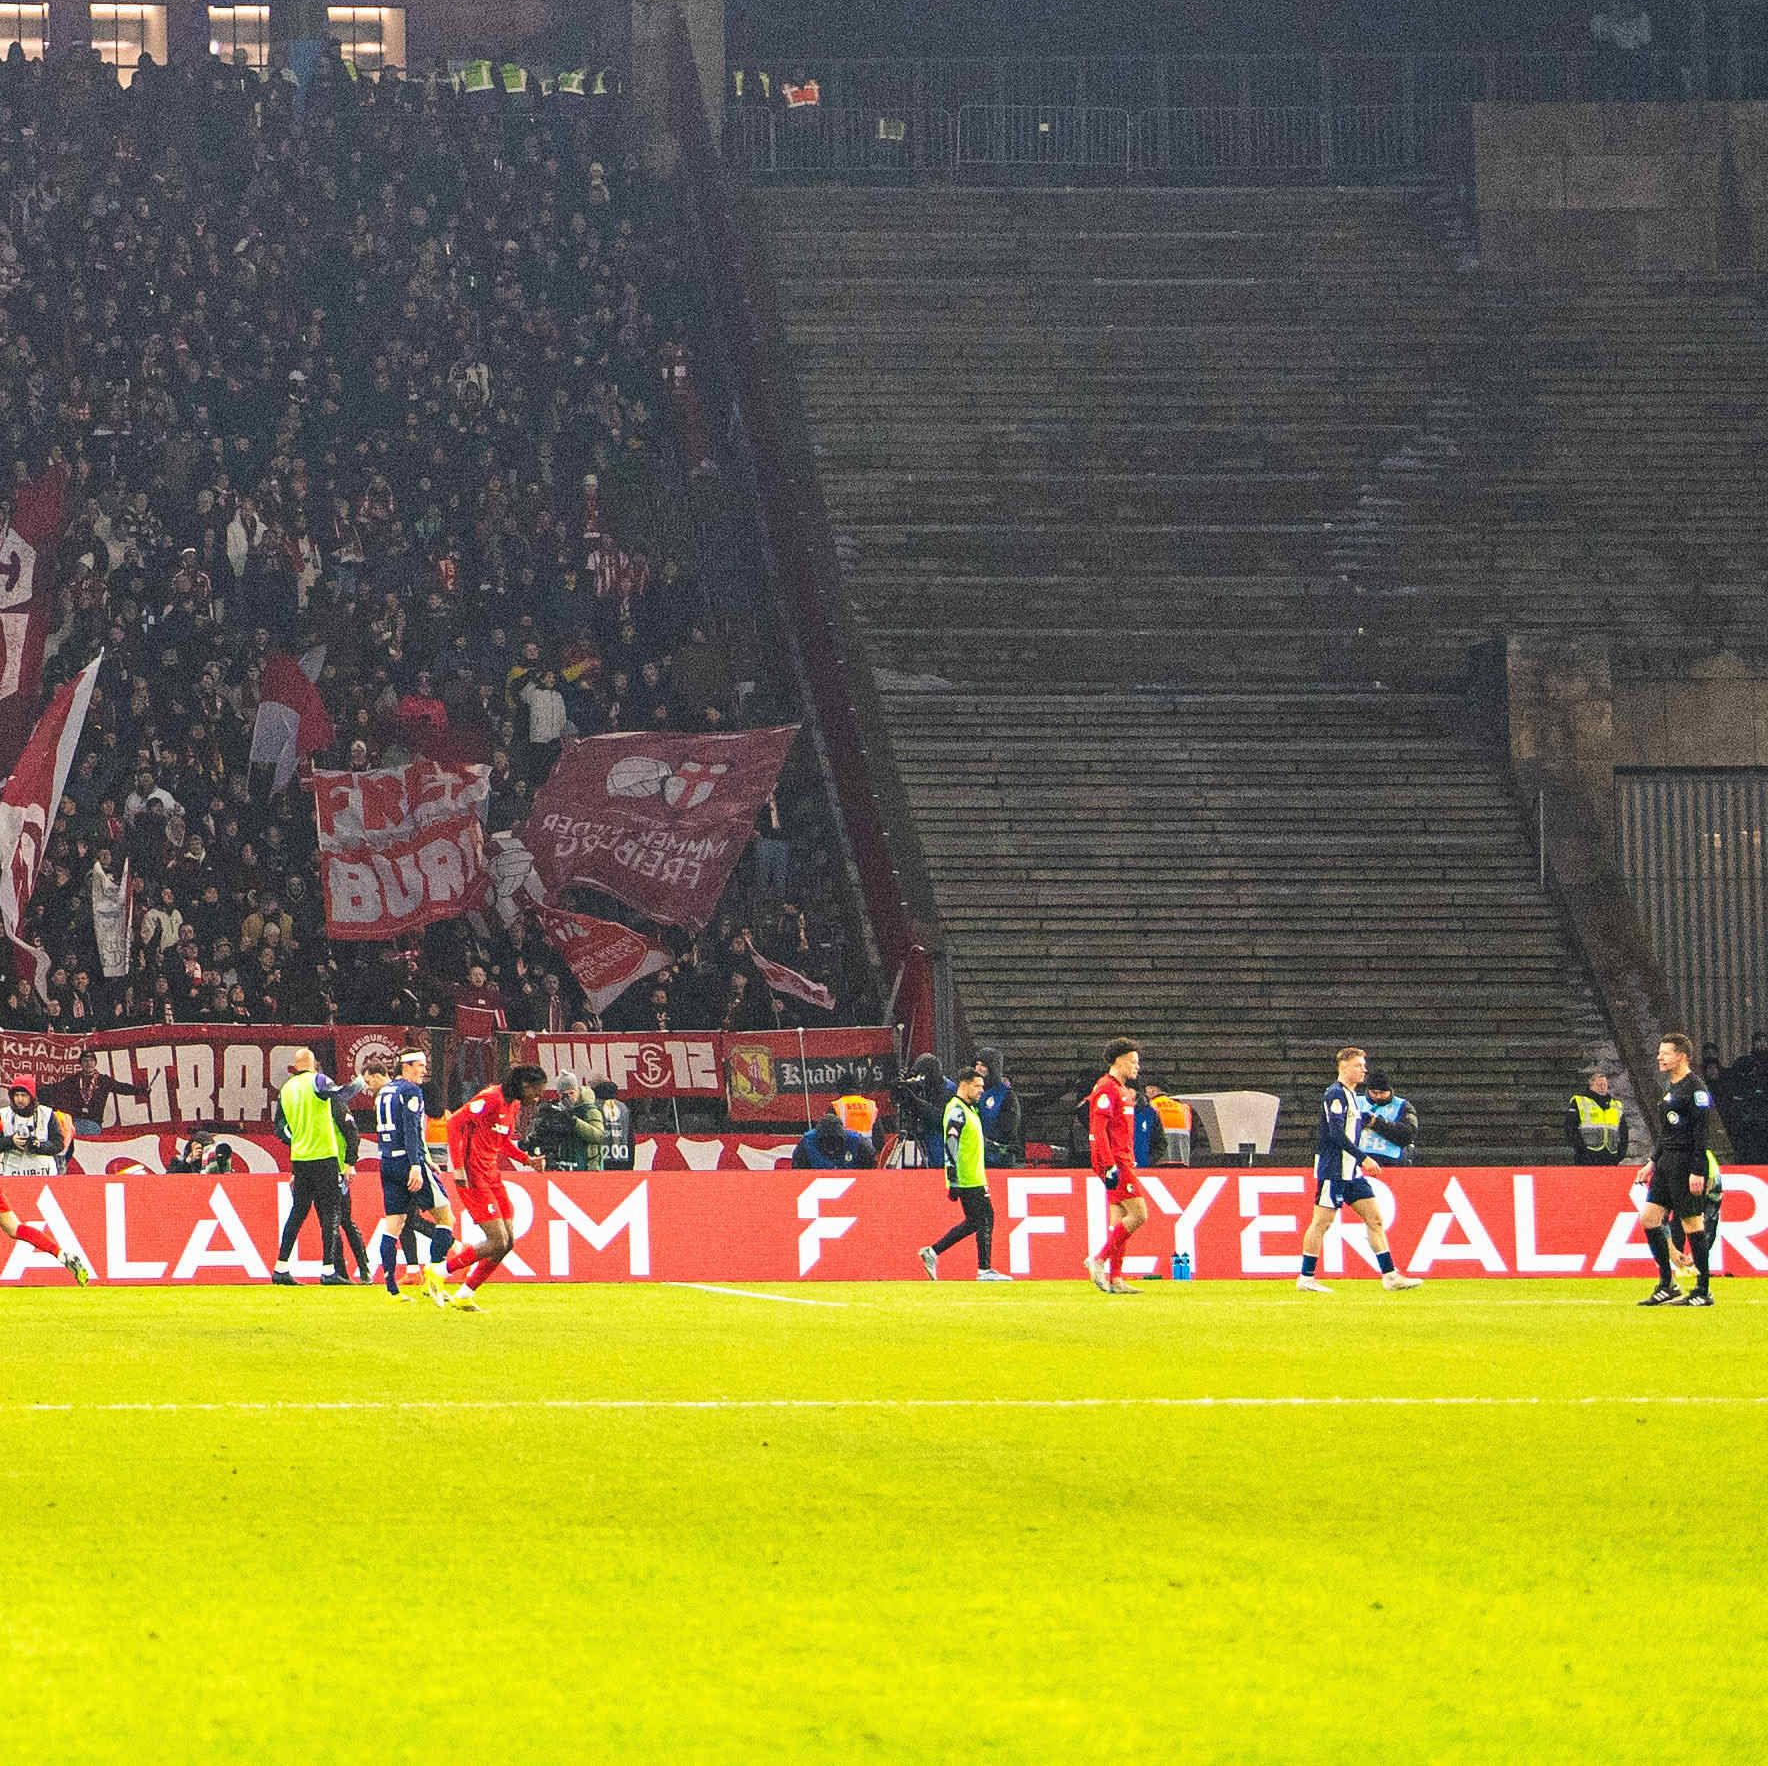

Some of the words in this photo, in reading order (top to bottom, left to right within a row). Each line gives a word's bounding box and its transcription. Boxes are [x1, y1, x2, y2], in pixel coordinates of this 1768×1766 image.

[328, 836, 473, 924] BUR
[3, 1039, 82, 1061] KHALID
[663, 1040, 719, 1089] 12
[375, 1093, 396, 1133] 11
[601, 1144, 629, 1159] 200
